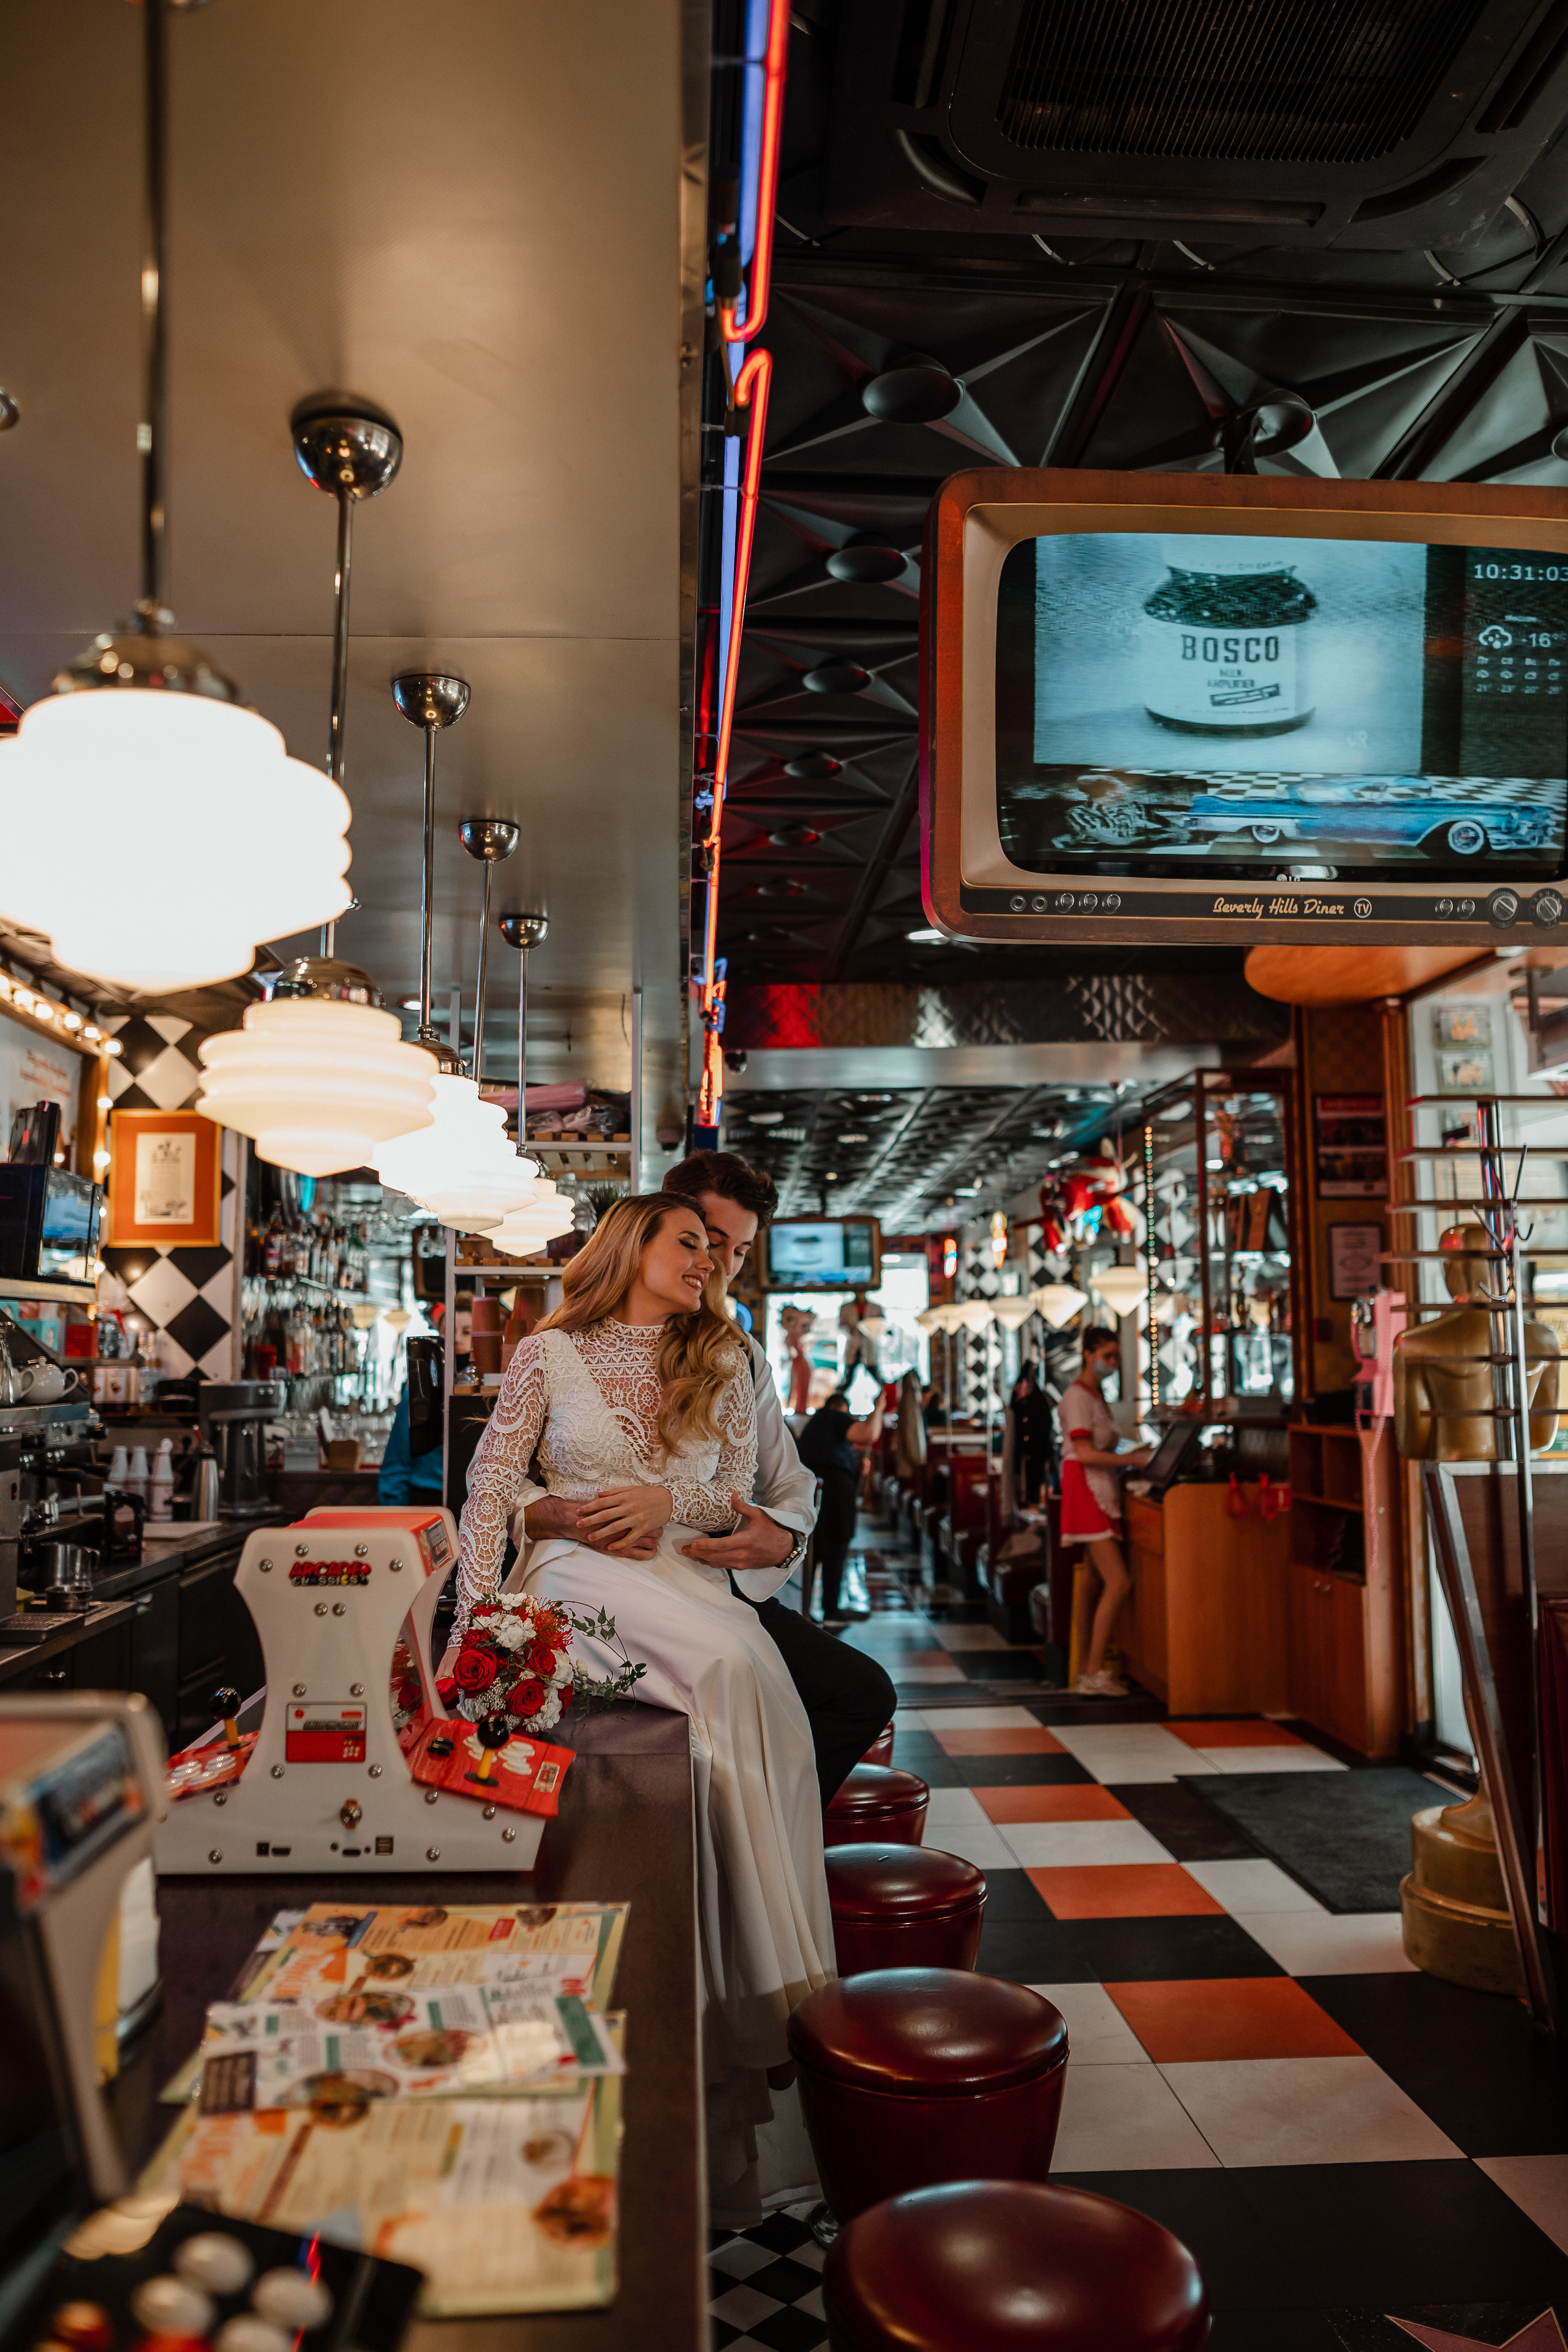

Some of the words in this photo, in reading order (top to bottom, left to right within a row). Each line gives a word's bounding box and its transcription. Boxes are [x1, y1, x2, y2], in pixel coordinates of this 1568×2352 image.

[1474, 564, 1568, 581] 10:31:03
[1181, 633, 1279, 663] BOSCO
[1213, 897, 1264, 919] Beverly
[1269, 897, 1299, 915] Hills
[1303, 899, 1344, 915] Diner
[1357, 903, 1370, 914] TV
